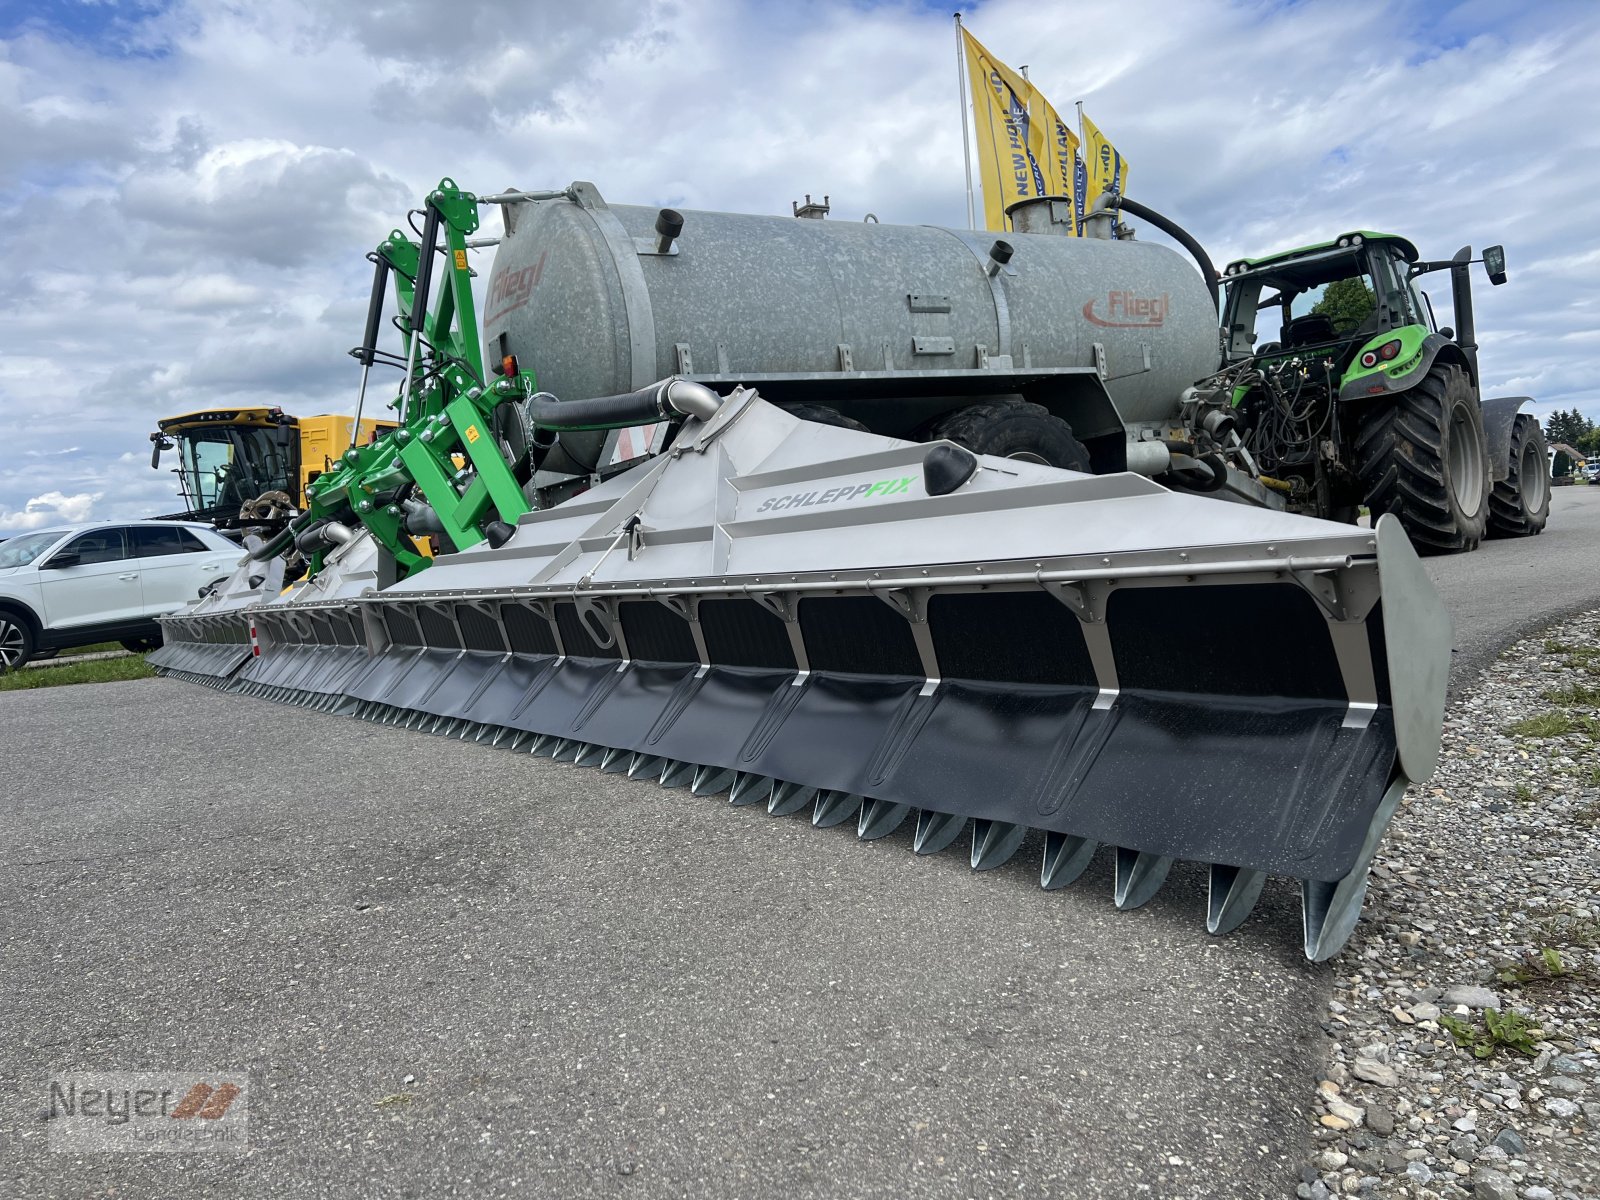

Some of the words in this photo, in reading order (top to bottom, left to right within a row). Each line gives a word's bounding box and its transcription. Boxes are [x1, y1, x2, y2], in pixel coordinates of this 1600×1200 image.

[1013, 153, 1028, 197] NEW
[1055, 118, 1069, 189] HOLLAN
[490, 250, 548, 309] Fliegl
[1108, 290, 1169, 322] Fliegl
[757, 475, 918, 513] SCHLEPPFIX
